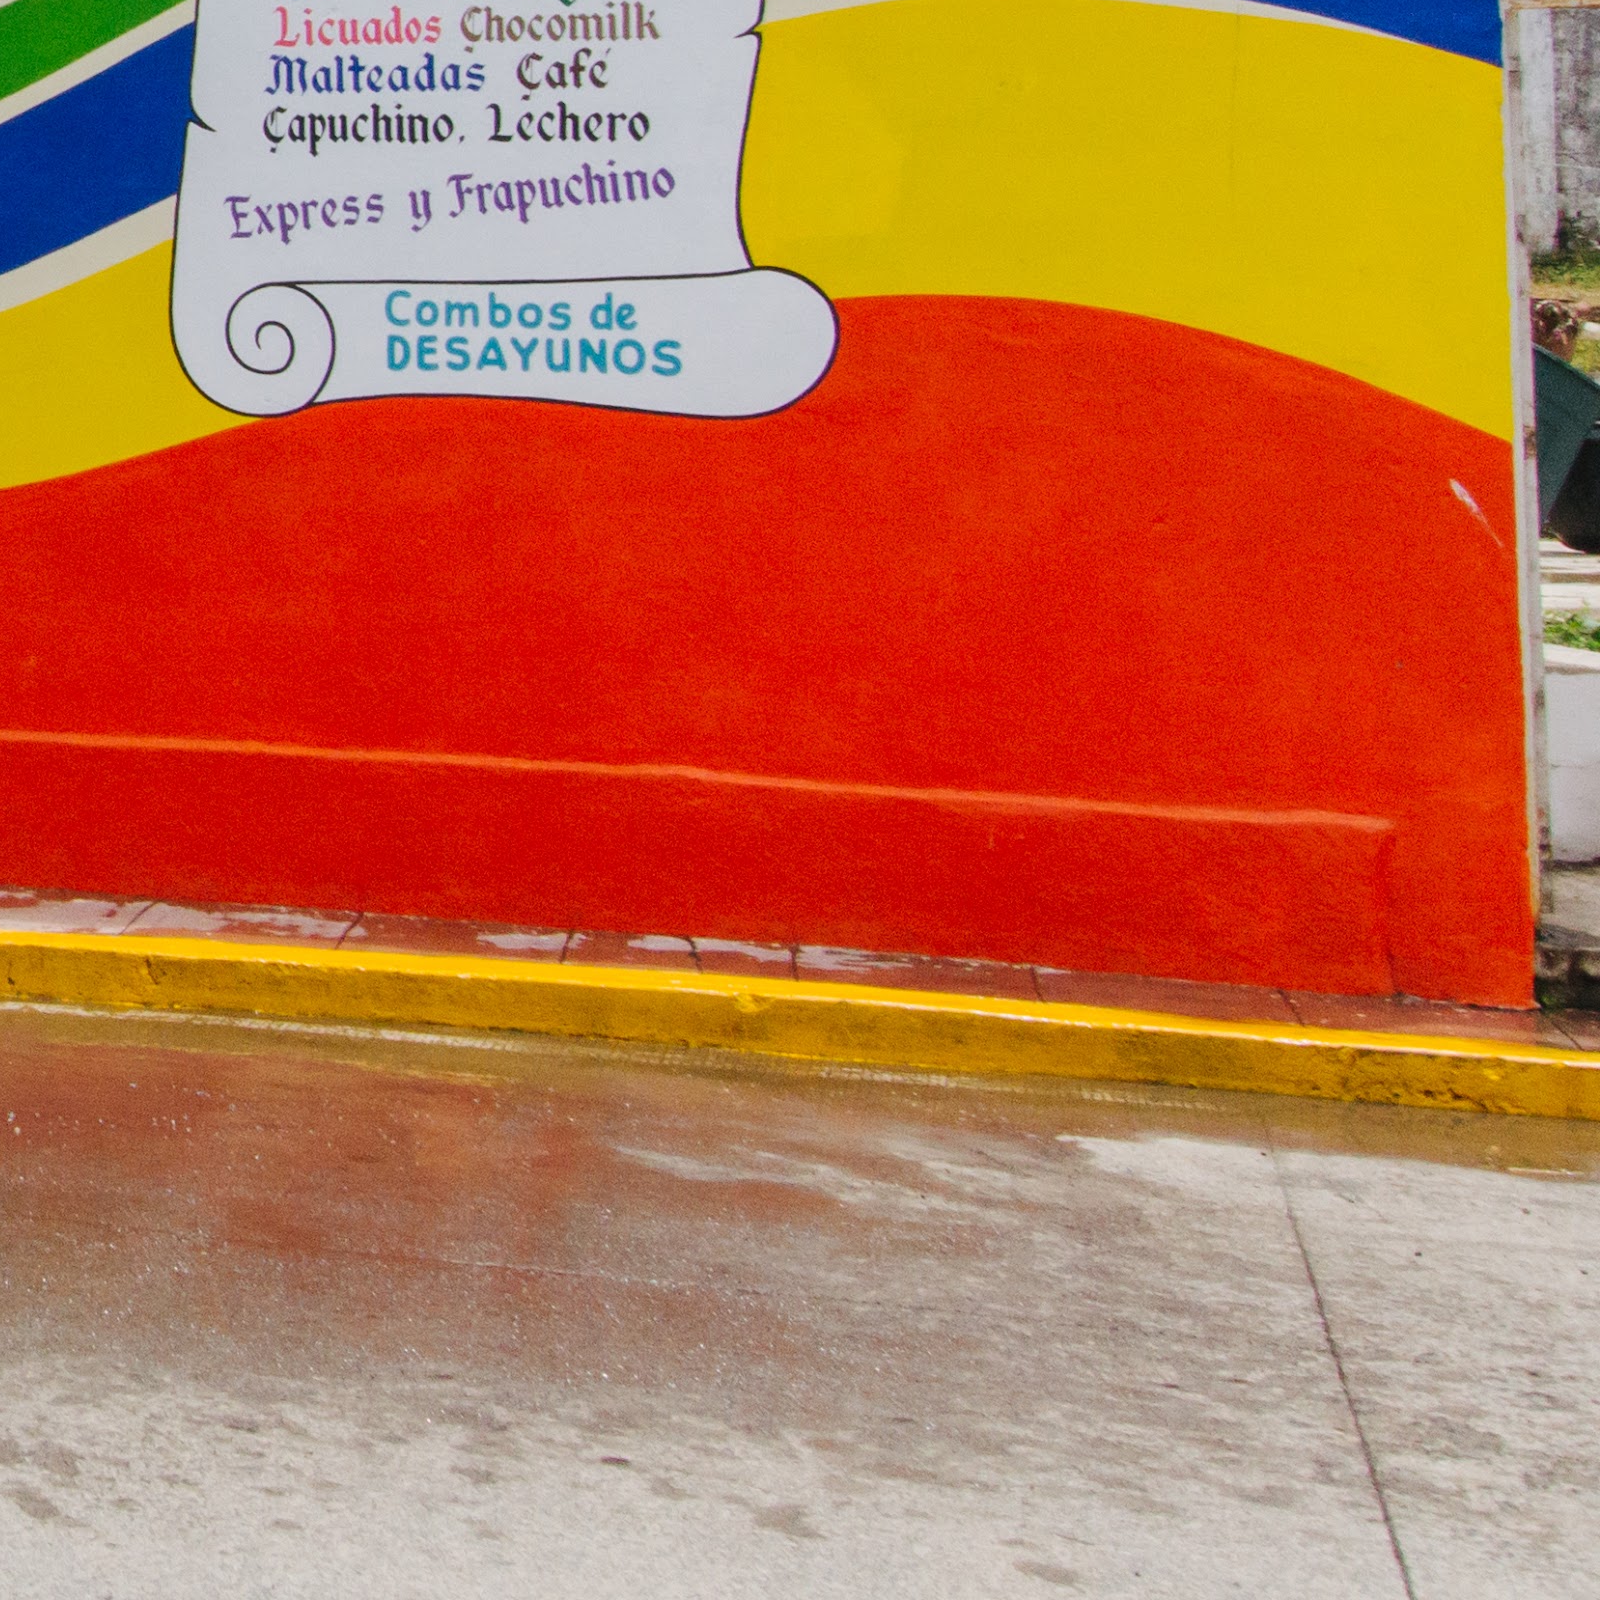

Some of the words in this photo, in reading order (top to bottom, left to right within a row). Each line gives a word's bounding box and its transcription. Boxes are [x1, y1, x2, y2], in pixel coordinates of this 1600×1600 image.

[273, 5, 442, 48] Licuados
[460, 1, 661, 53] Chocomilk
[264, 52, 486, 95] Malteadas
[515, 47, 612, 101] Café
[486, 100, 652, 144] Lechero
[224, 193, 385, 245] Express
[408, 189, 432, 232] y
[447, 160, 676, 224] Frapuchino
[384, 288, 573, 332] Combos
[589, 292, 639, 332] de
[385, 334, 684, 378] DESAYUNOS
